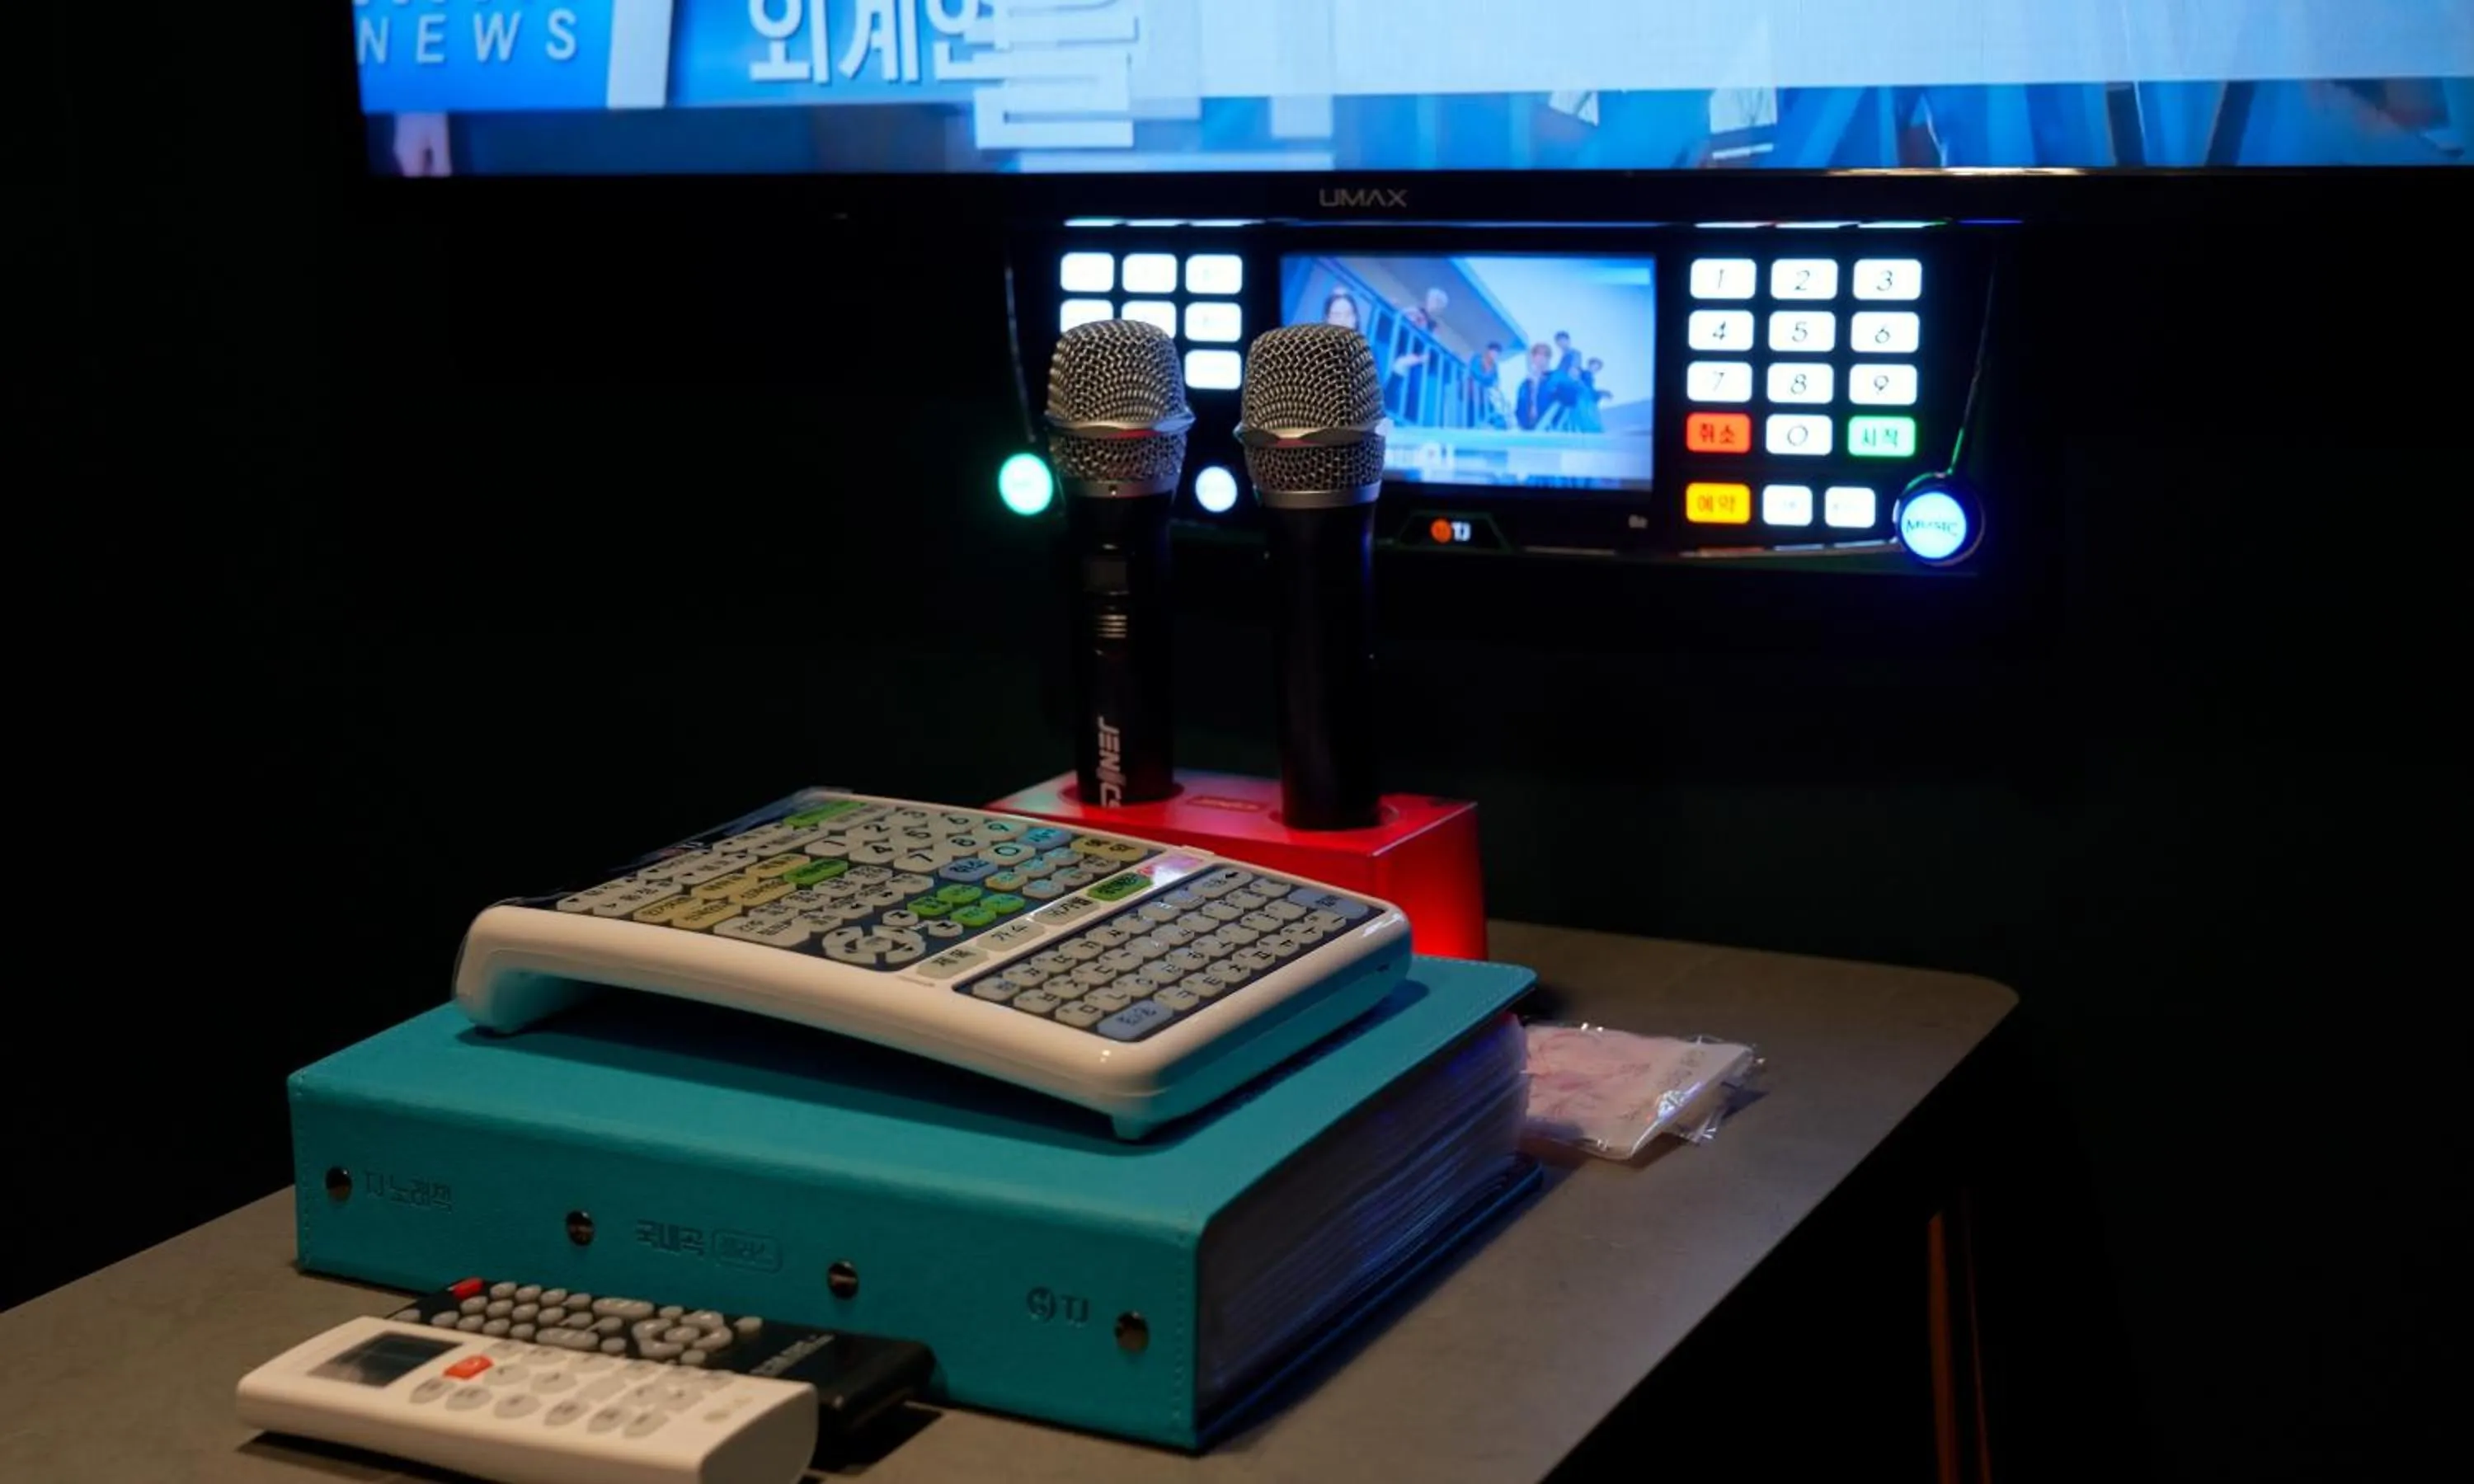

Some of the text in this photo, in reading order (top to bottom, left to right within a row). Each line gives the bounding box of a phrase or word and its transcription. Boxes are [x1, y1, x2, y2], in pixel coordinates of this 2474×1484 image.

[356, 8, 576, 65] NEWS
[1319, 189, 1408, 208] UMAX
[1794, 270, 1811, 291] 2
[1876, 270, 1893, 291] 3
[1712, 320, 1727, 340] 4
[1791, 321, 1808, 342] 5
[1874, 324, 1891, 344] 6
[1712, 370, 1725, 392] 7
[1790, 373, 1807, 395] 8
[1873, 374, 1889, 395] 9
[1787, 425, 1808, 446] 0
[1860, 428, 1899, 448] 시작
[1061, 1294, 1089, 1322] TJ
